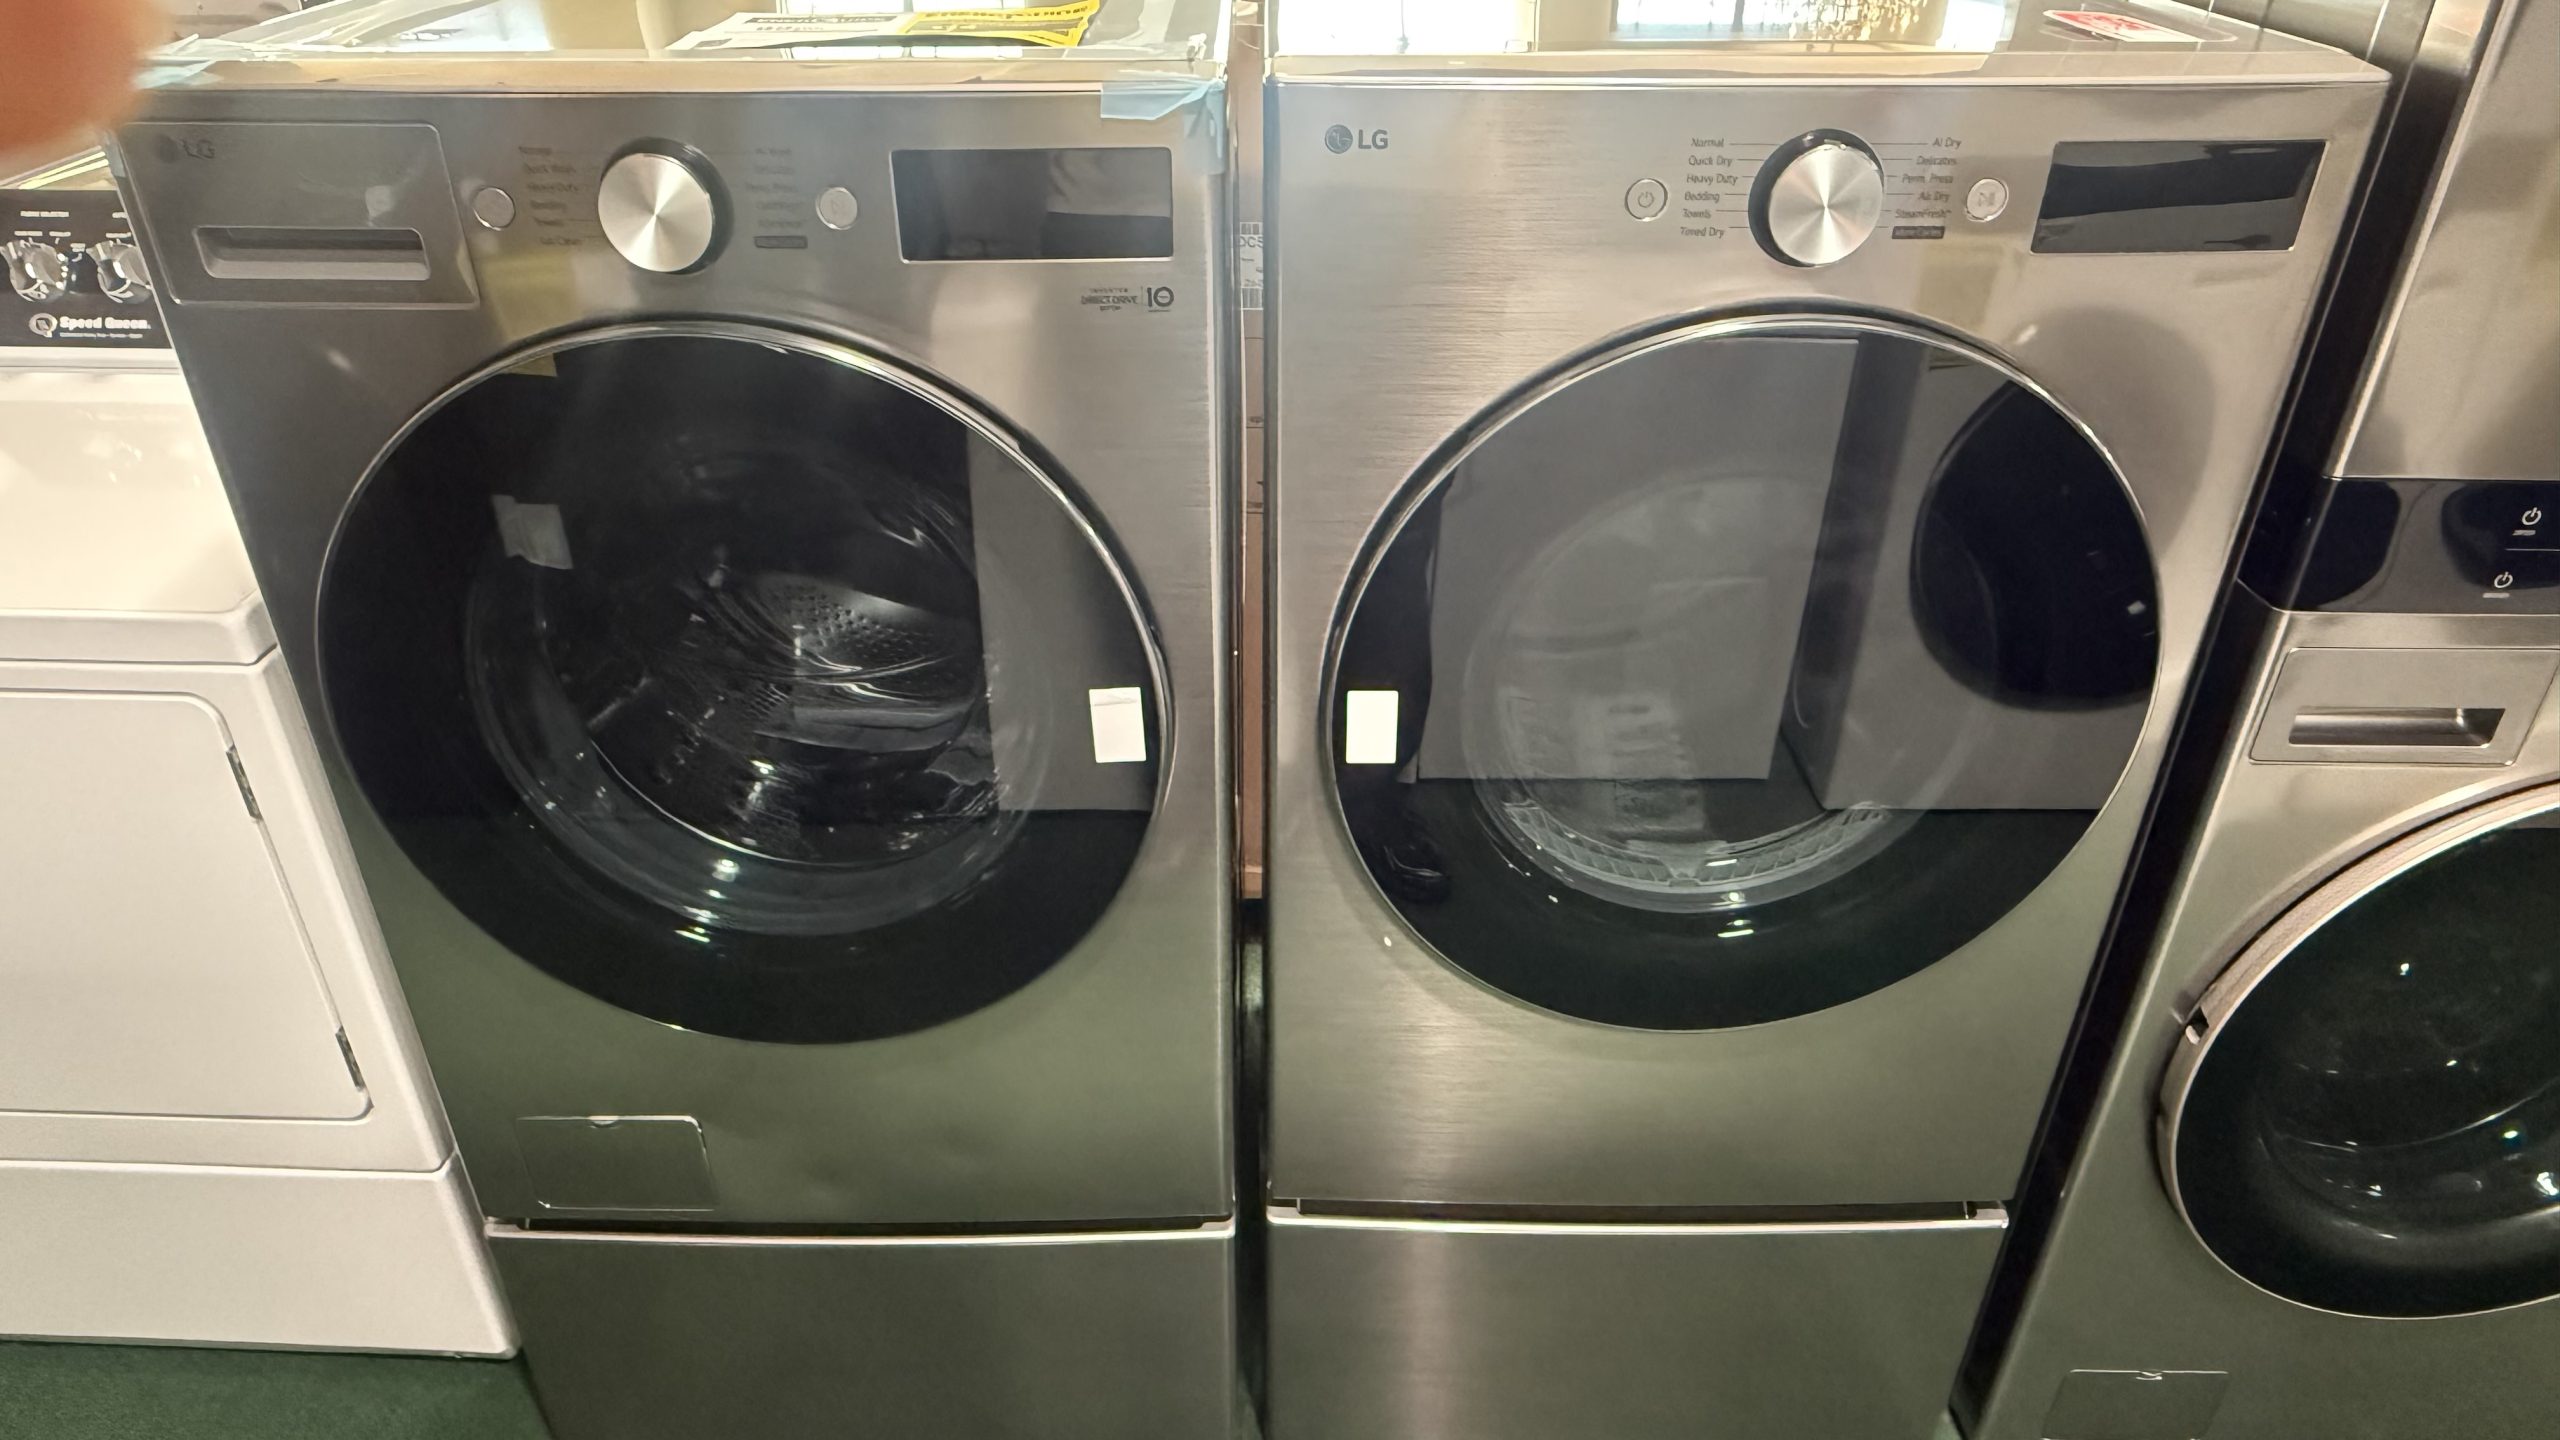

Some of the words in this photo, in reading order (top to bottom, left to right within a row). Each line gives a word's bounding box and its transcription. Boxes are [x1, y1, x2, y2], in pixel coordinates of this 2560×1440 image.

[1358, 129, 1388, 149] LG
[1691, 138, 1724, 148] Normal
[1945, 137, 1961, 149] Dry
[183, 139, 216, 159] LG
[1688, 155, 1713, 166] Quick
[1716, 155, 1732, 168] Dry
[1916, 155, 1957, 166] Delicates
[1686, 173, 1713, 186] Heavy
[1716, 173, 1738, 186] Duty
[1685, 191, 1720, 204] Bedding
[1934, 191, 1950, 203] Dry
[1683, 208, 1711, 219] Towels
[1680, 226, 1706, 237] Timed
[1708, 226, 1725, 239] Dry
[1147, 286, 1175, 307] 10
[60, 316, 102, 330] Speed
[105, 317, 147, 329] Queen
